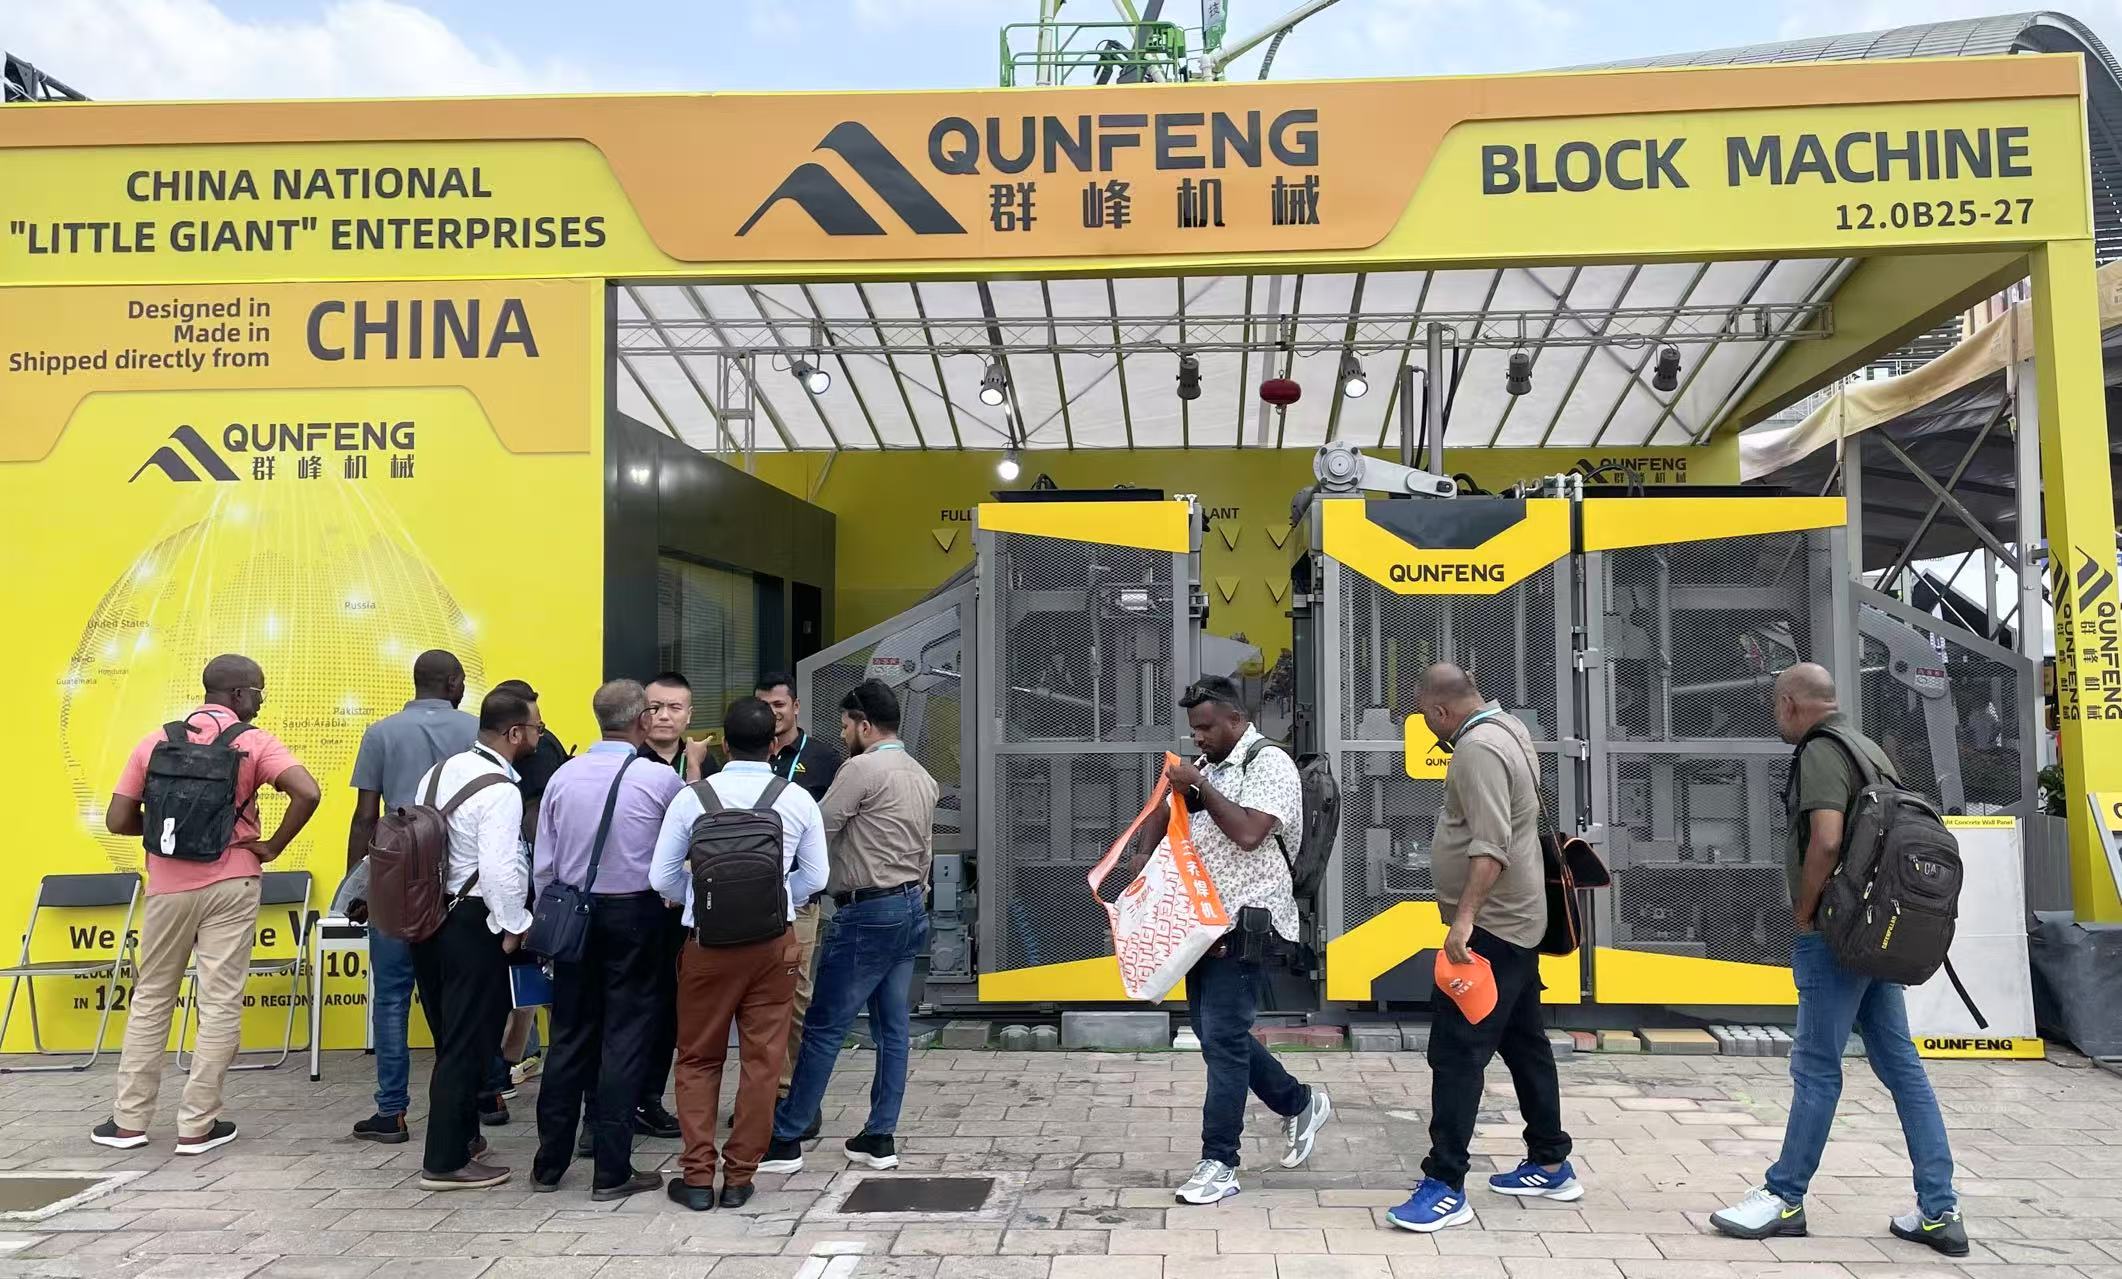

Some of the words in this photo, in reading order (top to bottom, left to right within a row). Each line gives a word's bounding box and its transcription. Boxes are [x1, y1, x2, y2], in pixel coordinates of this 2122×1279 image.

[928, 109, 1319, 176] QUNFENG
[1482, 138, 1690, 196] BLOCK
[1727, 127, 2033, 187] MACHINE
[126, 169, 260, 202] CHINA
[273, 166, 492, 201] NATIONAL
[989, 175, 1320, 232] 群峰机械
[1836, 198, 2034, 231] 12.0B25-27
[10, 220, 156, 254] "LITTLE
[169, 217, 318, 253] GIANT"
[331, 216, 606, 251] ENTERPRISES
[128, 300, 240, 323] Designed
[249, 298, 271, 318] in
[174, 323, 240, 344] Made
[249, 323, 270, 343] in
[307, 298, 540, 362] CHINA
[9, 350, 107, 376] Shipped
[114, 348, 206, 373] directly
[212, 348, 270, 368] from
[223, 422, 415, 452] QUNFENG
[252, 454, 415, 480] 群峰机械
[1389, 563, 1505, 583] QUNFENG
[344, 601, 376, 610] Russia
[121, 619, 149, 628] States
[2063, 603, 2080, 720] QUNFENG
[2097, 602, 2122, 720] QUNFENG
[313, 718, 347, 728] Arabia
[333, 707, 375, 716] Pakistan
[69, 925, 115, 949] We
[74, 997, 88, 1009] IN
[95, 985, 135, 1011] 12
[1923, 1038, 2013, 1051] QUNFENG
